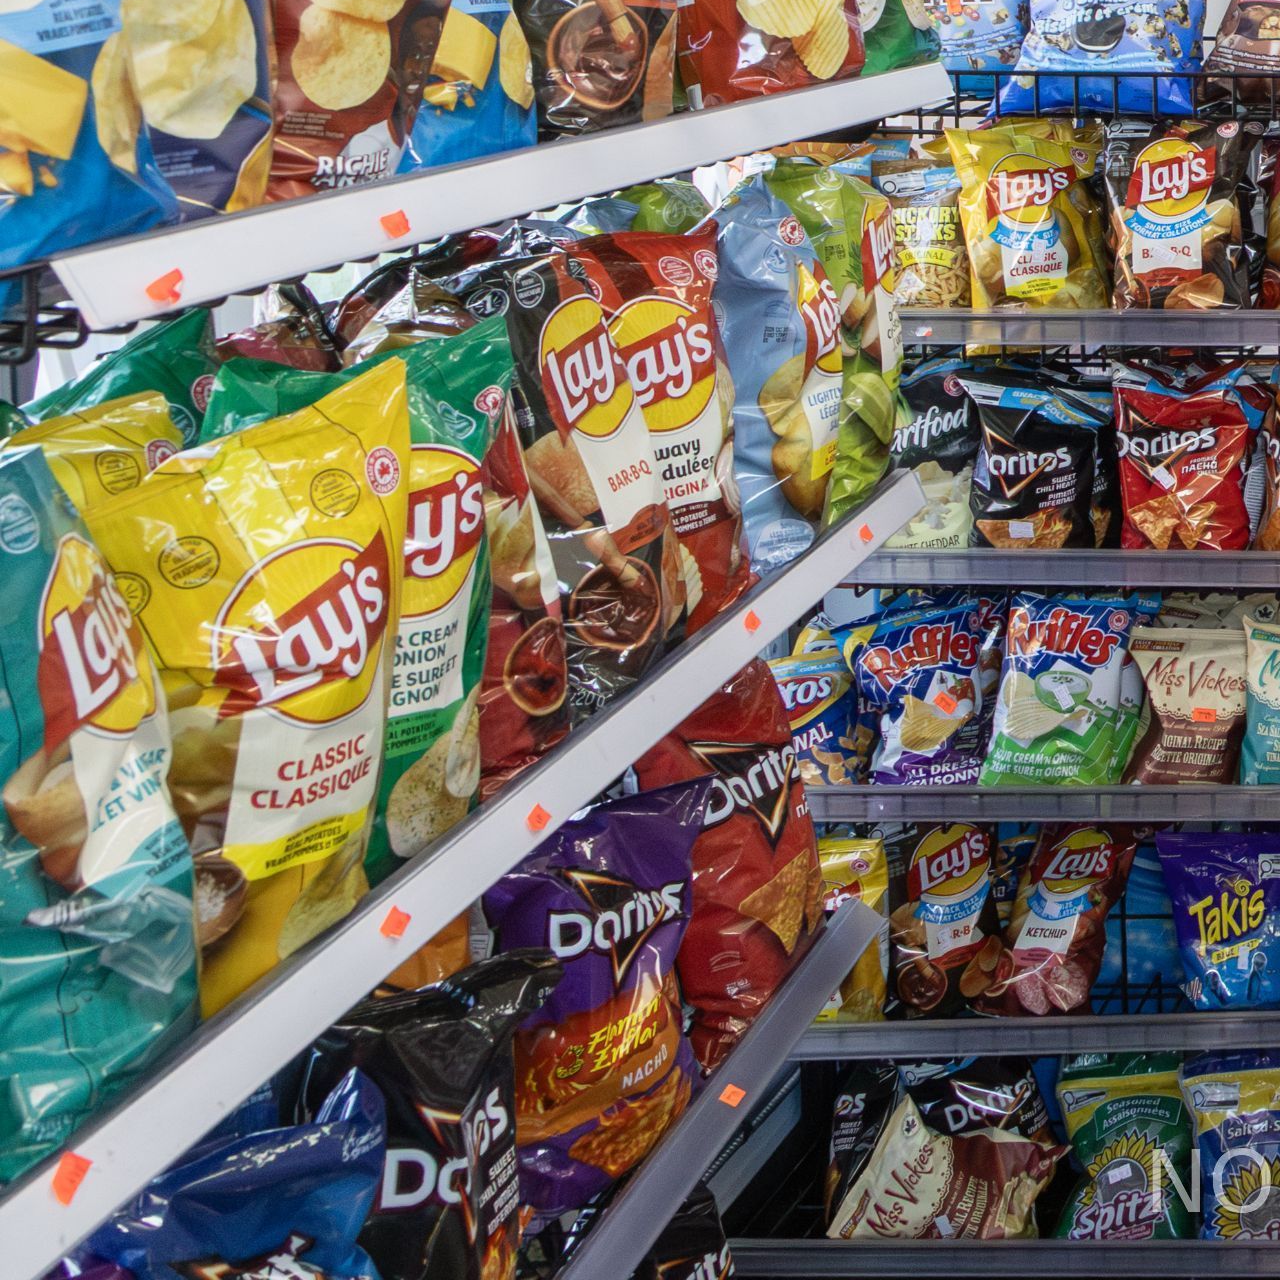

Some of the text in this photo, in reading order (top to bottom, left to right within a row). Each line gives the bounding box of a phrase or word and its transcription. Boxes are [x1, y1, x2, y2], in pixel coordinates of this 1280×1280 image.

[1006, 168, 1070, 208] Lay's
[1139, 153, 1208, 197] Lay's
[1010, 261, 1063, 278] CLASSIQUE
[890, 404, 969, 455] artfood
[1117, 427, 1215, 461] Doritos
[920, 534, 961, 549] CHEDDAR
[233, 558, 385, 707] Lay's
[409, 622, 458, 646] CREAM
[1006, 606, 1120, 667] Ruffles
[859, 623, 980, 694] Ruffles
[1145, 656, 1247, 700] Miss Vickie's
[277, 733, 367, 786] CLASSIC
[250, 755, 372, 812] CLASSIQUE
[916, 831, 987, 881] Lay's
[1042, 842, 1112, 881] Lay's
[551, 883, 684, 958] Doritos
[1025, 926, 1067, 941] KETCHUP
[1189, 884, 1265, 946] Takis
[622, 1044, 668, 1089] NACHO
[1106, 1097, 1161, 1115] Seasoned
[1074, 1189, 1163, 1233] Spitz
